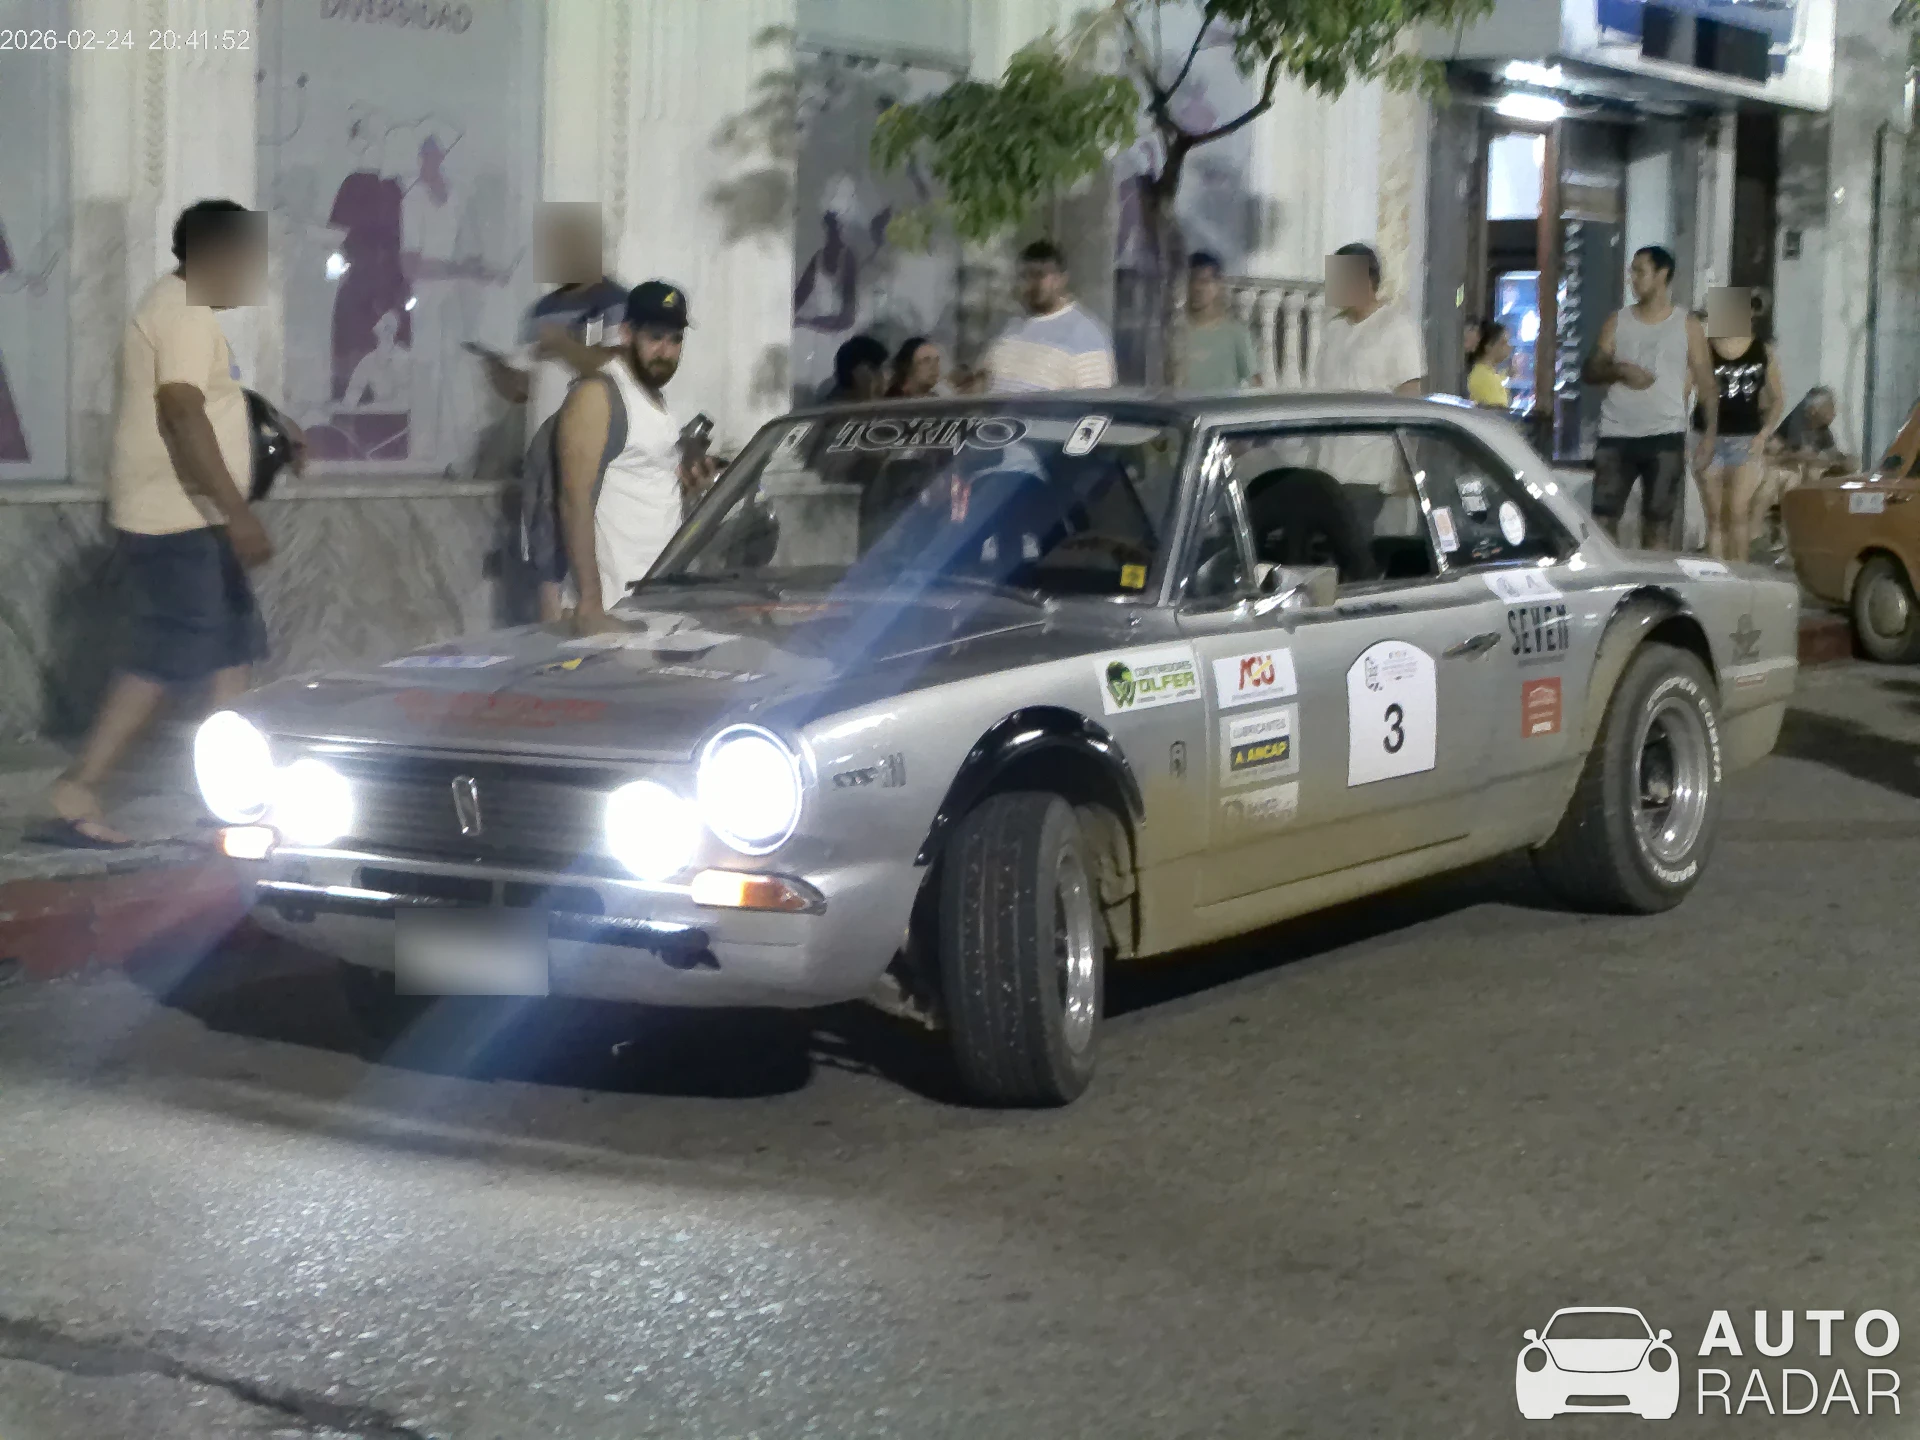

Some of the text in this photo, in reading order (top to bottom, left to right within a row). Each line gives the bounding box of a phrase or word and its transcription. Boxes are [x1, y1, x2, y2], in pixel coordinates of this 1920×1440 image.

[827, 416, 1029, 456] TORINO
[1507, 603, 1570, 656] SEVEN
[1383, 702, 1405, 754] 3
